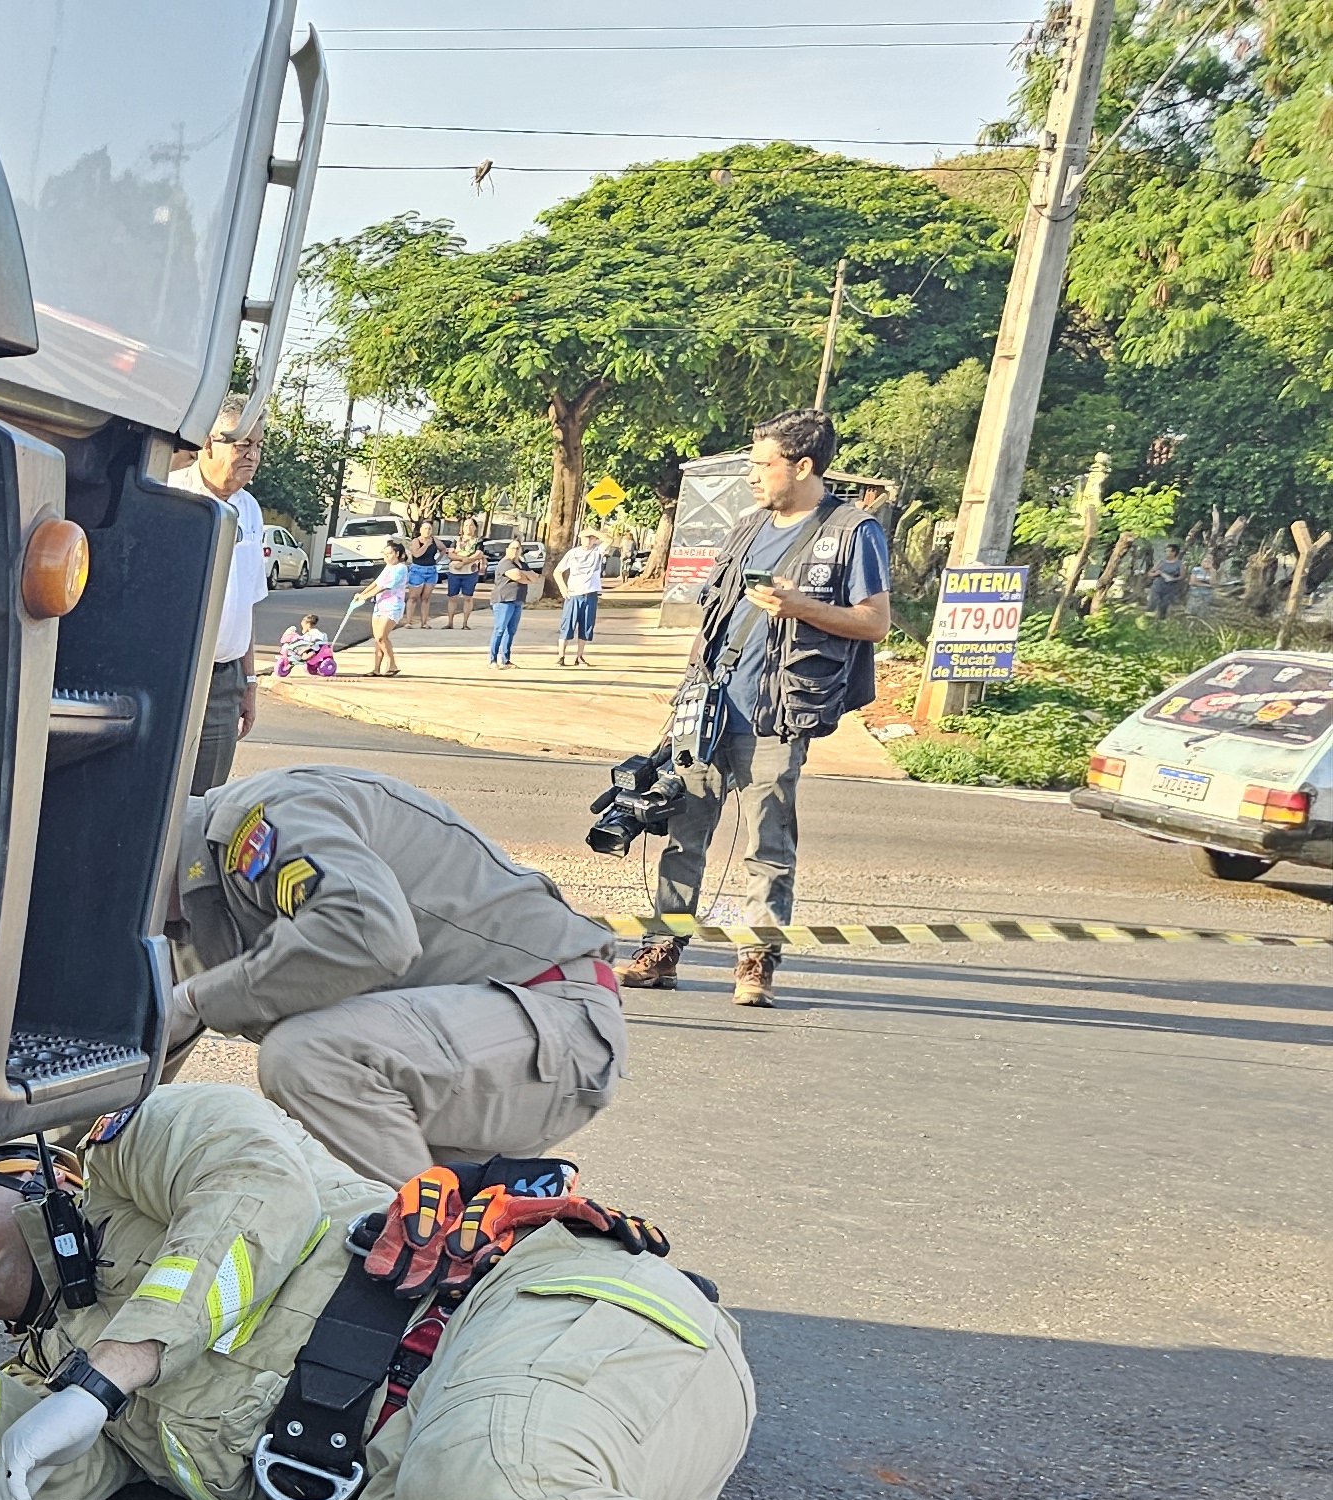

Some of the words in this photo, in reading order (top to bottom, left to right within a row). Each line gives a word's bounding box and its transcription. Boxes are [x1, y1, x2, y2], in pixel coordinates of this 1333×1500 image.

[815, 541, 835, 552] sbt
[946, 572, 1022, 593] BATERIA
[948, 607, 1018, 635] 179,00
[936, 644, 1013, 653] COMPRAMOS
[950, 654, 995, 665] Sucata
[933, 666, 949, 677] de
[953, 666, 1009, 677] baterias
